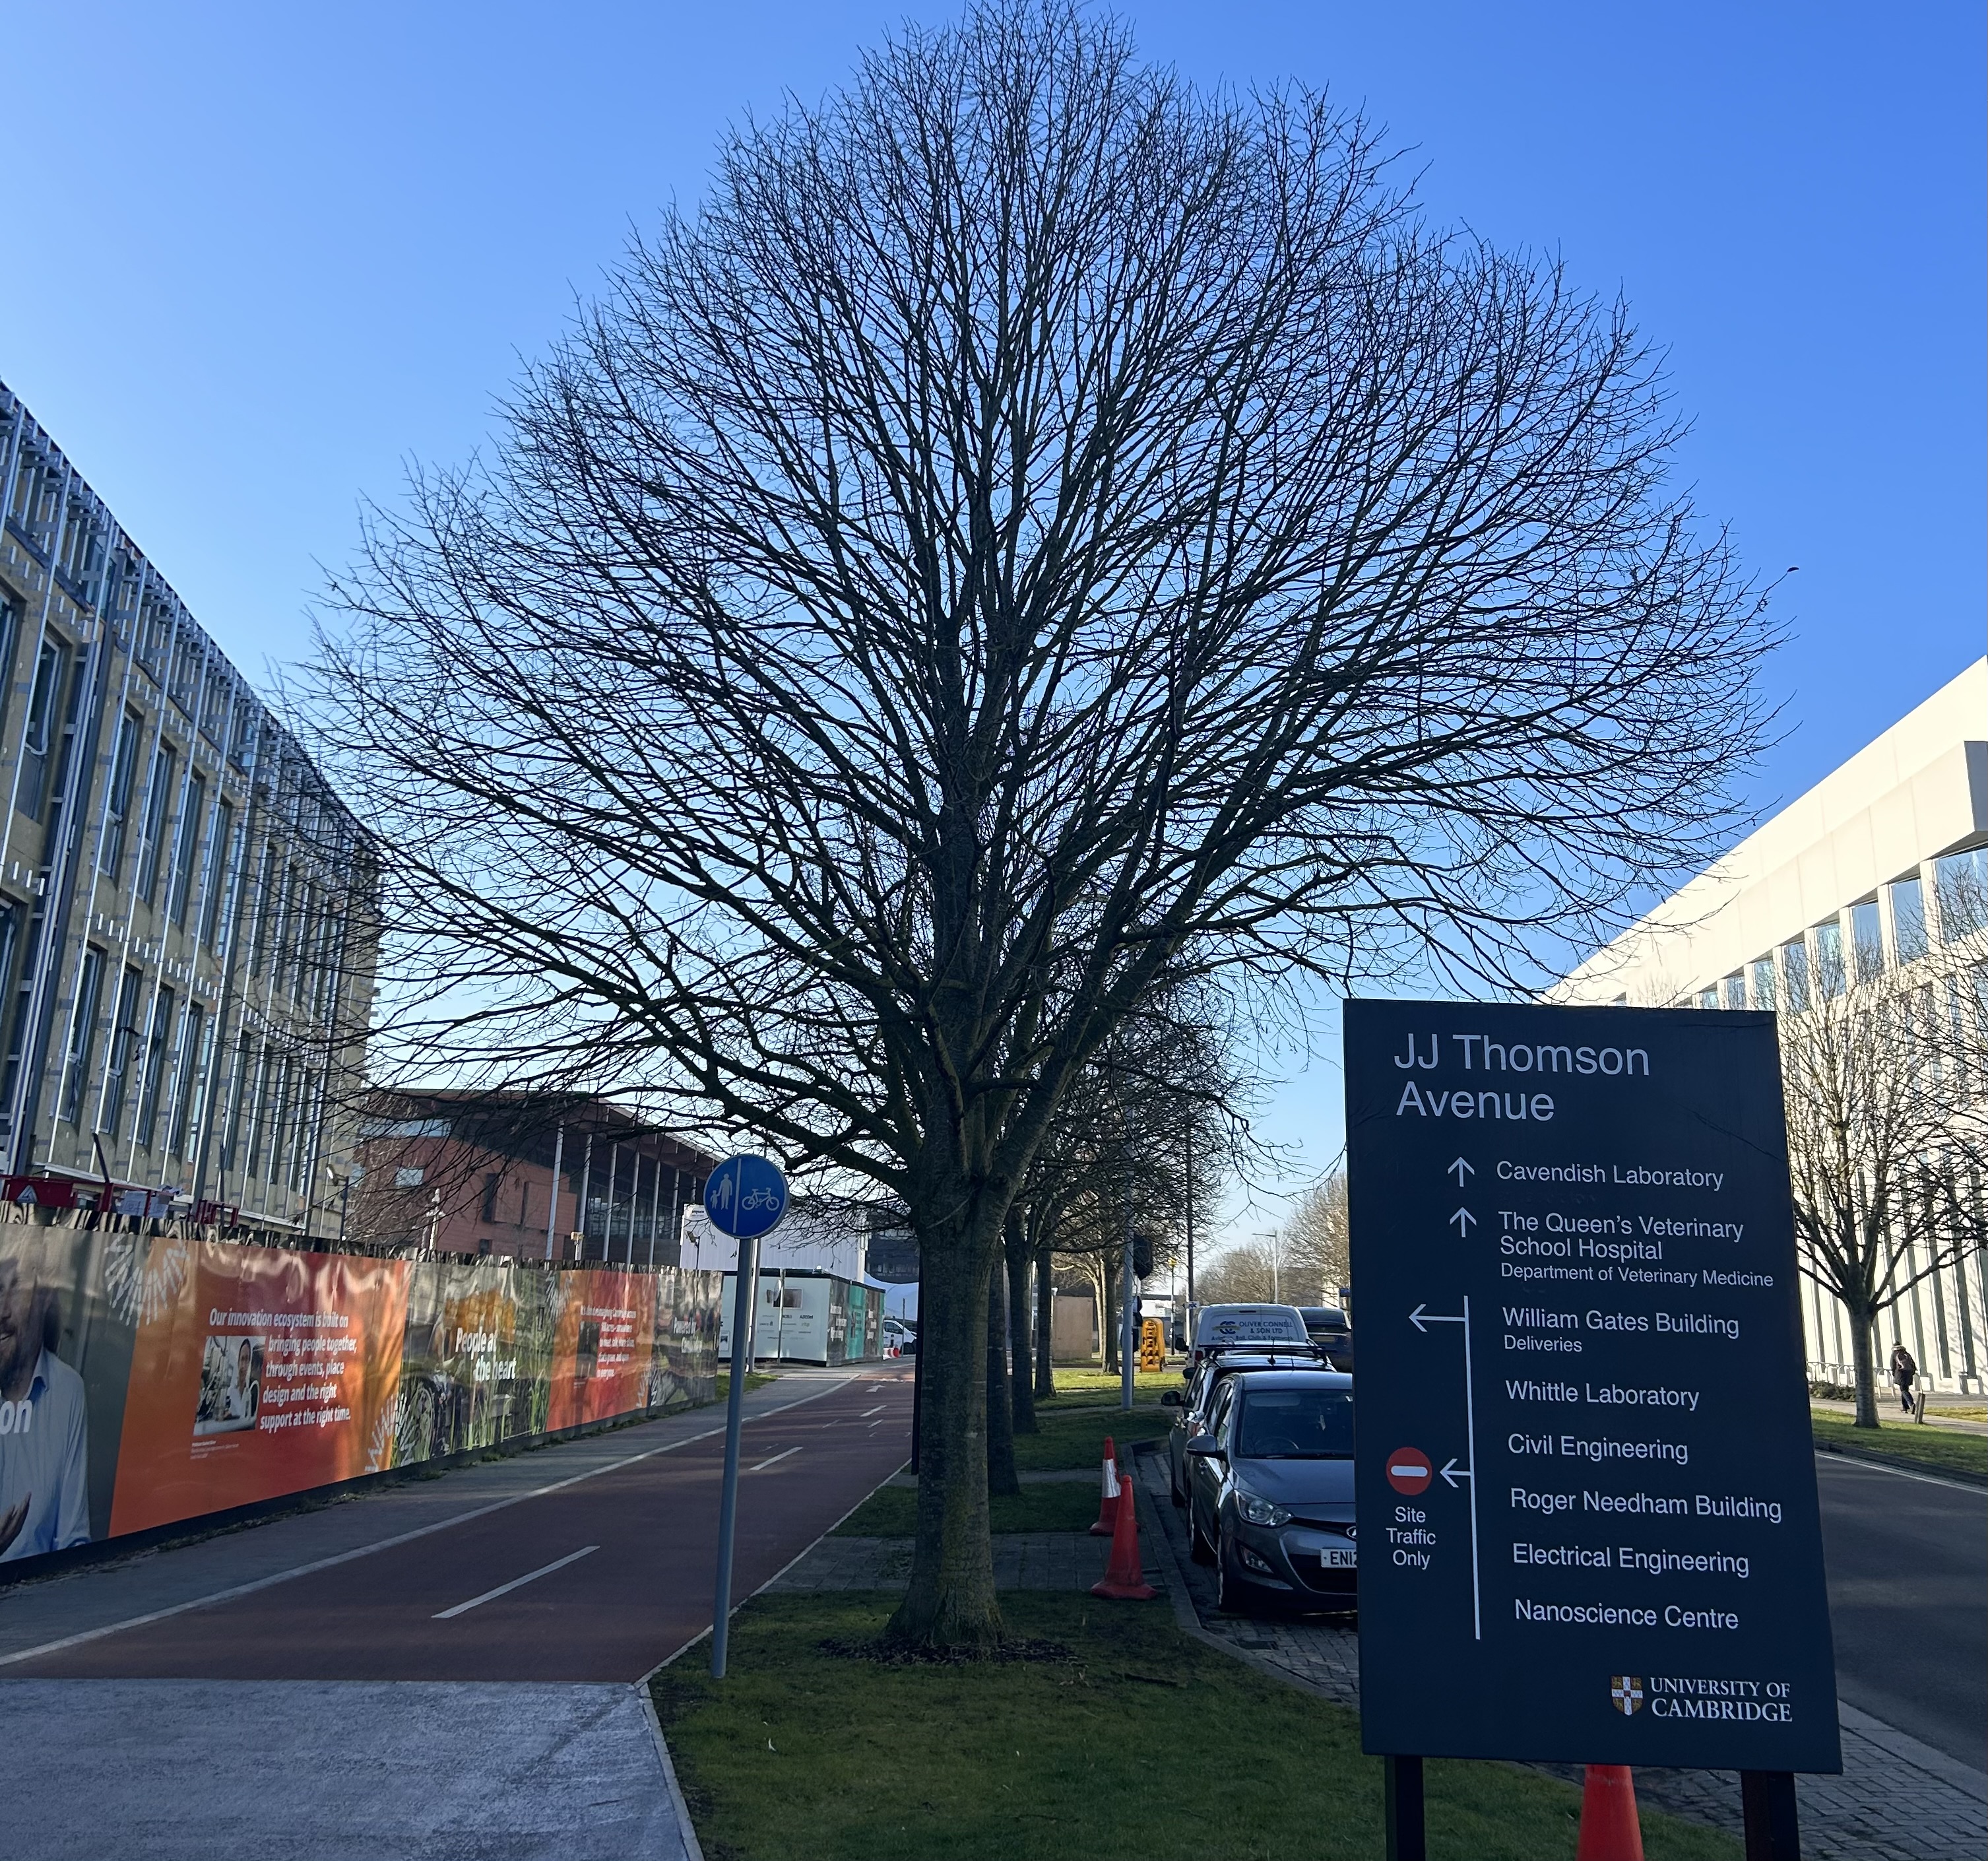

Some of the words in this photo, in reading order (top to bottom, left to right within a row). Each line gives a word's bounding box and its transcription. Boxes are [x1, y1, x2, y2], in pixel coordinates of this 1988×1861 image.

[1394, 1033, 1438, 1068] JJ
[1453, 1035, 1649, 1075] Thomson
[1396, 1082, 1554, 1121] Avenue
[1497, 1161, 1605, 1183] Cavendish
[1614, 1165, 1723, 1191] Laboratory
[1498, 1212, 1538, 1231] The
[1638, 1216, 1743, 1243] Veterinary
[1500, 1235, 1570, 1256] School
[1579, 1239, 1662, 1263] Hospital
[1502, 1262, 1593, 1281] Department
[1599, 1267, 1613, 1280] of
[1618, 1267, 1698, 1287] Veterinary
[1703, 1270, 1773, 1286] Medicine
[209, 1308, 227, 1326] Our
[228, 1308, 272, 1326] innovation
[274, 1313, 314, 1332] ecosystem
[315, 1310, 321, 1327] is
[322, 1310, 339, 1328] built
[340, 1315, 348, 1328] on
[1502, 1307, 1578, 1328] William
[1586, 1310, 1648, 1331] Gates
[1656, 1313, 1739, 1339] Building
[268, 1334, 302, 1356] bringing
[302, 1336, 326, 1356] people
[327, 1335, 357, 1354] together,
[455, 1326, 487, 1360] People
[488, 1329, 497, 1352] at
[1504, 1335, 1582, 1352] Deliveries
[266, 1359, 297, 1381] through
[299, 1361, 325, 1378] events,
[325, 1359, 344, 1379] place
[475, 1355, 491, 1381] the
[491, 1355, 517, 1380] heart
[263, 1385, 289, 1407] design
[290, 1384, 306, 1401] and
[307, 1383, 319, 1400] the
[319, 1382, 337, 1404] right
[1506, 1380, 1578, 1402] Whittle
[1586, 1383, 1699, 1411] Laboratory
[260, 1412, 292, 1433] support
[293, 1410, 302, 1425] at
[303, 1408, 315, 1424] the
[316, 1406, 333, 1427] right
[335, 1405, 351, 1421] time.
[1508, 1433, 1552, 1454] Civil
[1561, 1436, 1688, 1464] Engineering
[1395, 1507, 1425, 1522] Site
[1511, 1488, 1576, 1514] Roger
[1584, 1491, 1688, 1514] Needham
[1696, 1495, 1781, 1523] Building
[1386, 1528, 1436, 1544] Traffic
[1393, 1550, 1430, 1570] Only
[1514, 1543, 1611, 1567] Electrical
[1619, 1548, 1748, 1578] Engineering
[1516, 1599, 1657, 1625] Nanoscience
[1665, 1606, 1738, 1629] Centre
[1650, 1678, 1760, 1696] UNIVERSITY
[1767, 1683, 1790, 1697] OF
[1652, 1699, 1792, 1722] CAMBRIDGE
